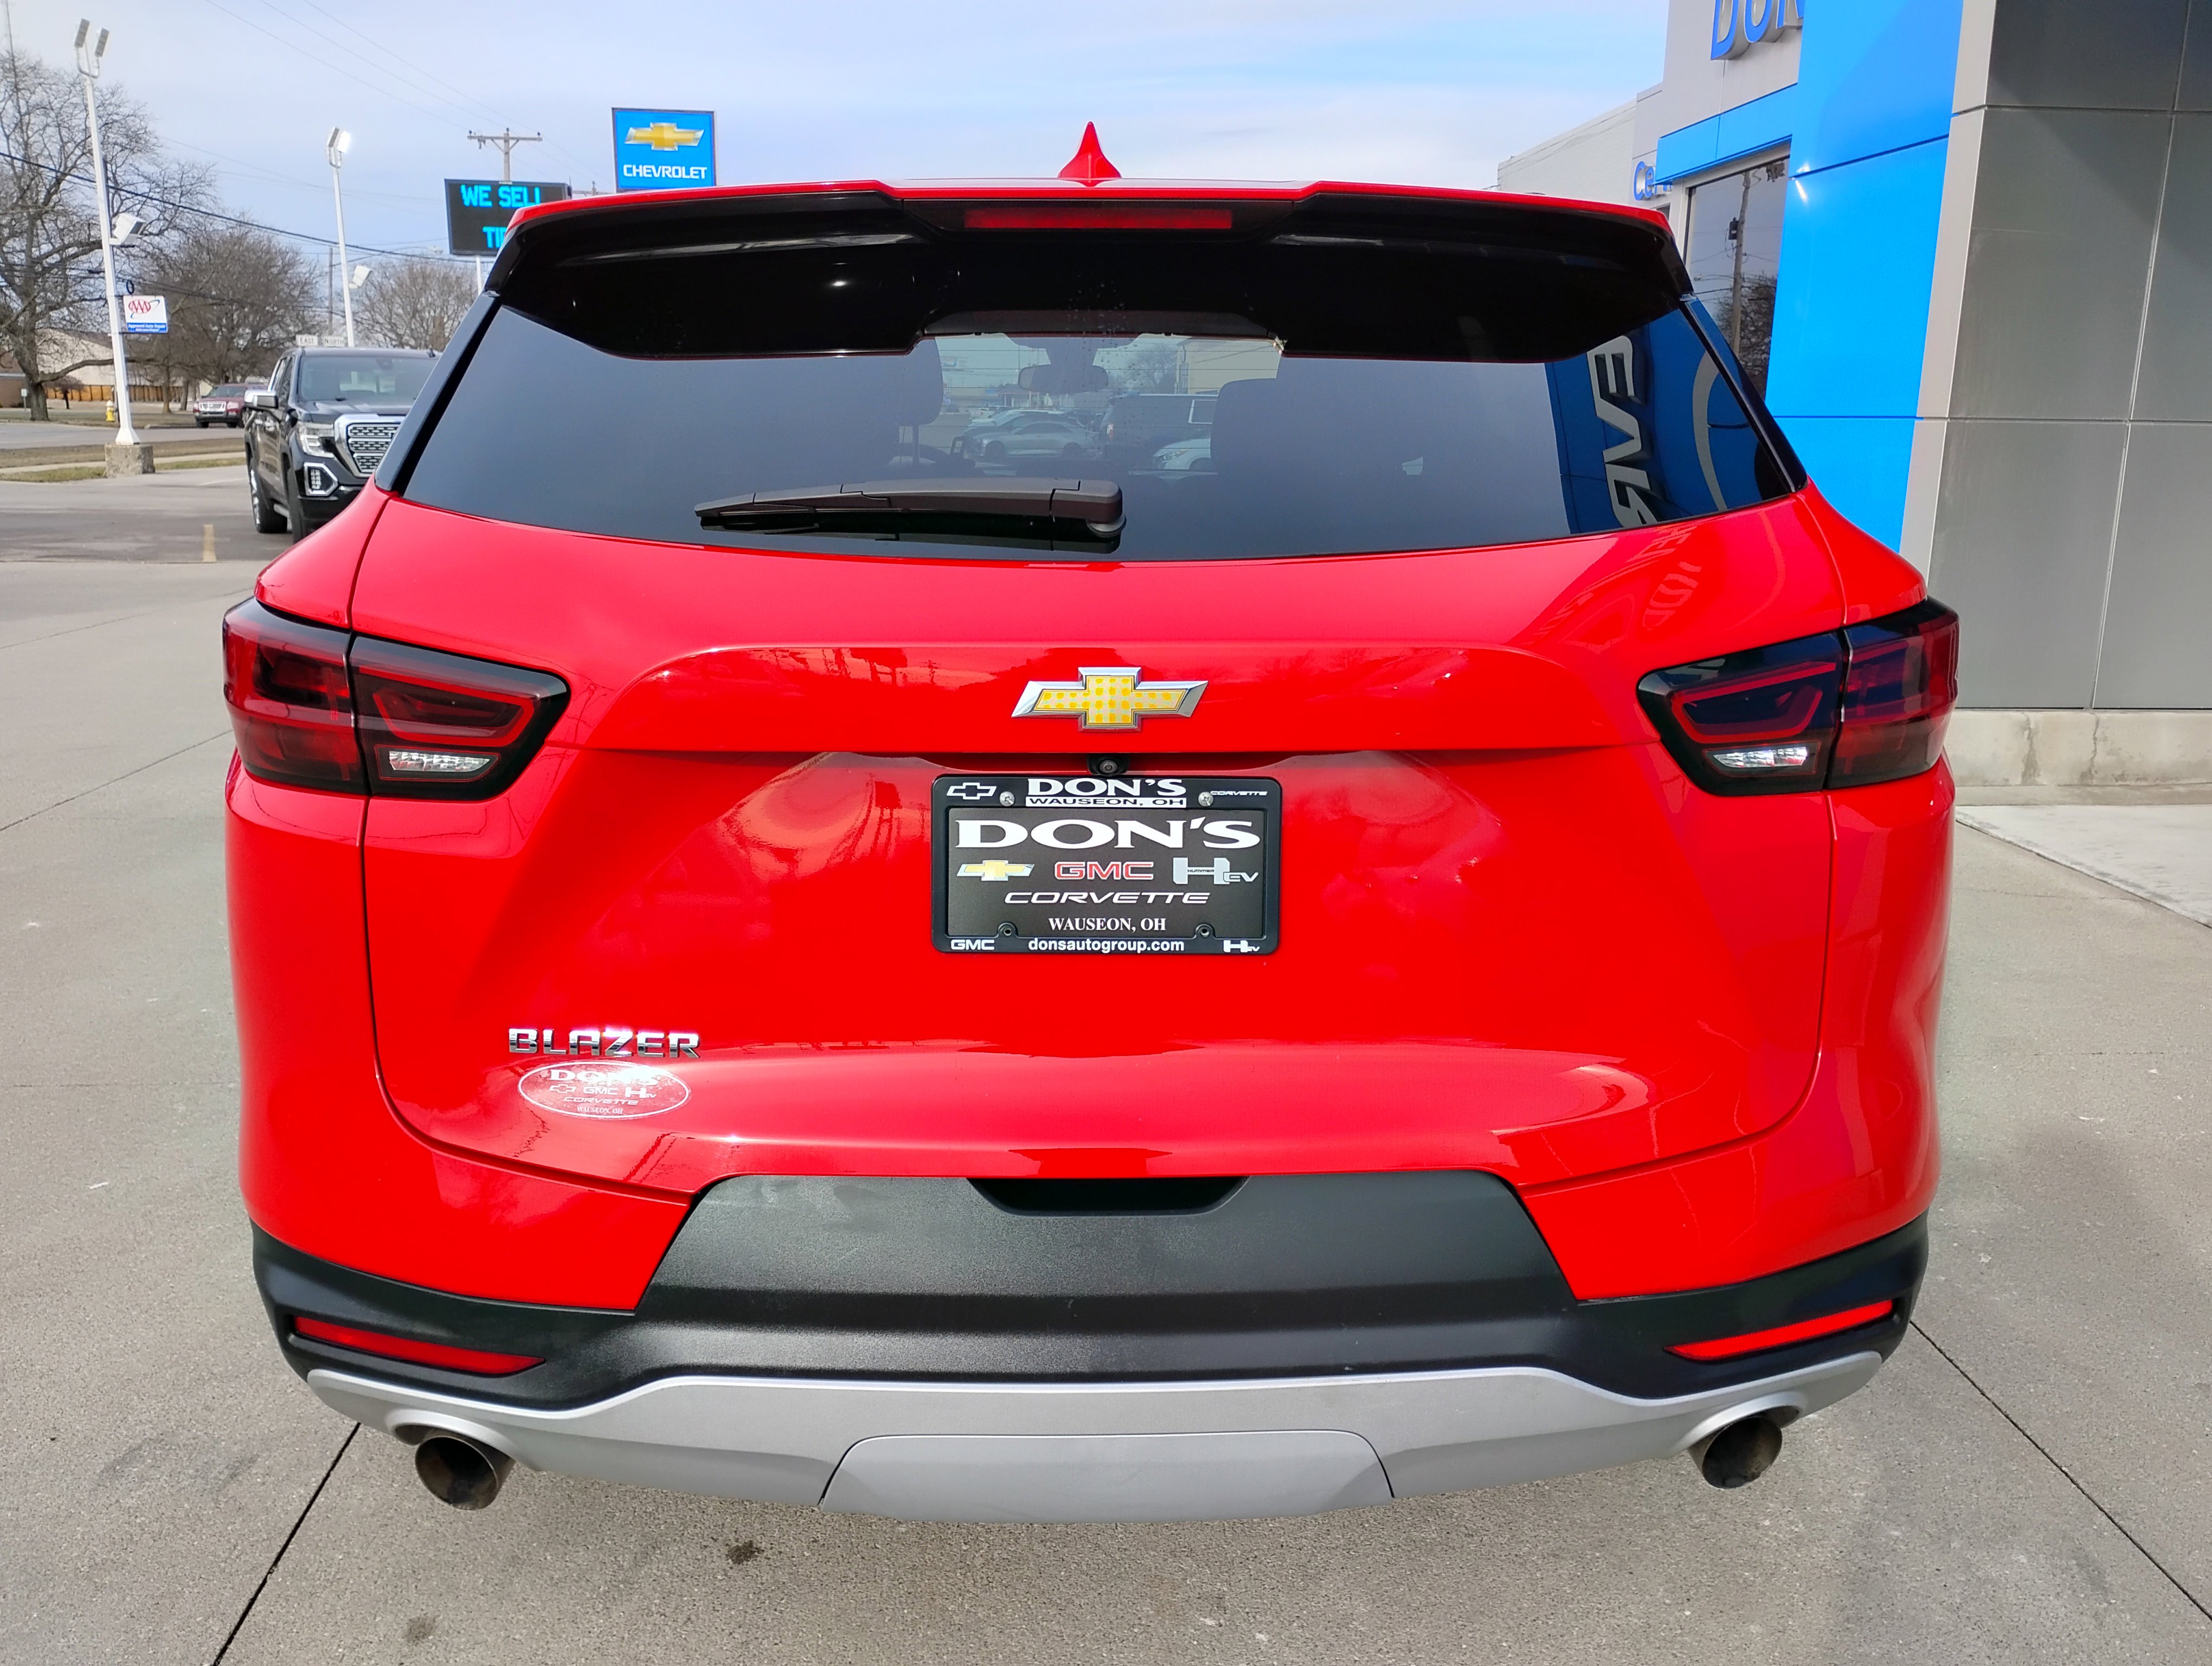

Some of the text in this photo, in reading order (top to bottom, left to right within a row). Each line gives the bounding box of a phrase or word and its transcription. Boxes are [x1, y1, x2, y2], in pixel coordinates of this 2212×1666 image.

[623, 164, 707, 179] CHEVROLET
[461, 184, 492, 207] WE
[129, 299, 151, 313] AAA
[1028, 778, 1186, 796] DON'S
[1029, 798, 1185, 807] WAUSEON, OH
[955, 817, 1261, 849] DON'S
[1054, 861, 1154, 881] GMC
[1004, 892, 1211, 904] CORVETTE
[1049, 918, 1166, 932] WAUSEON, OH
[951, 939, 995, 950] GMC
[1028, 938, 1184, 953] donsautogroup.com
[509, 1028, 700, 1058] BLAZER
[583, 1086, 618, 1095] GMC
[564, 1097, 639, 1105] CORVETTE
